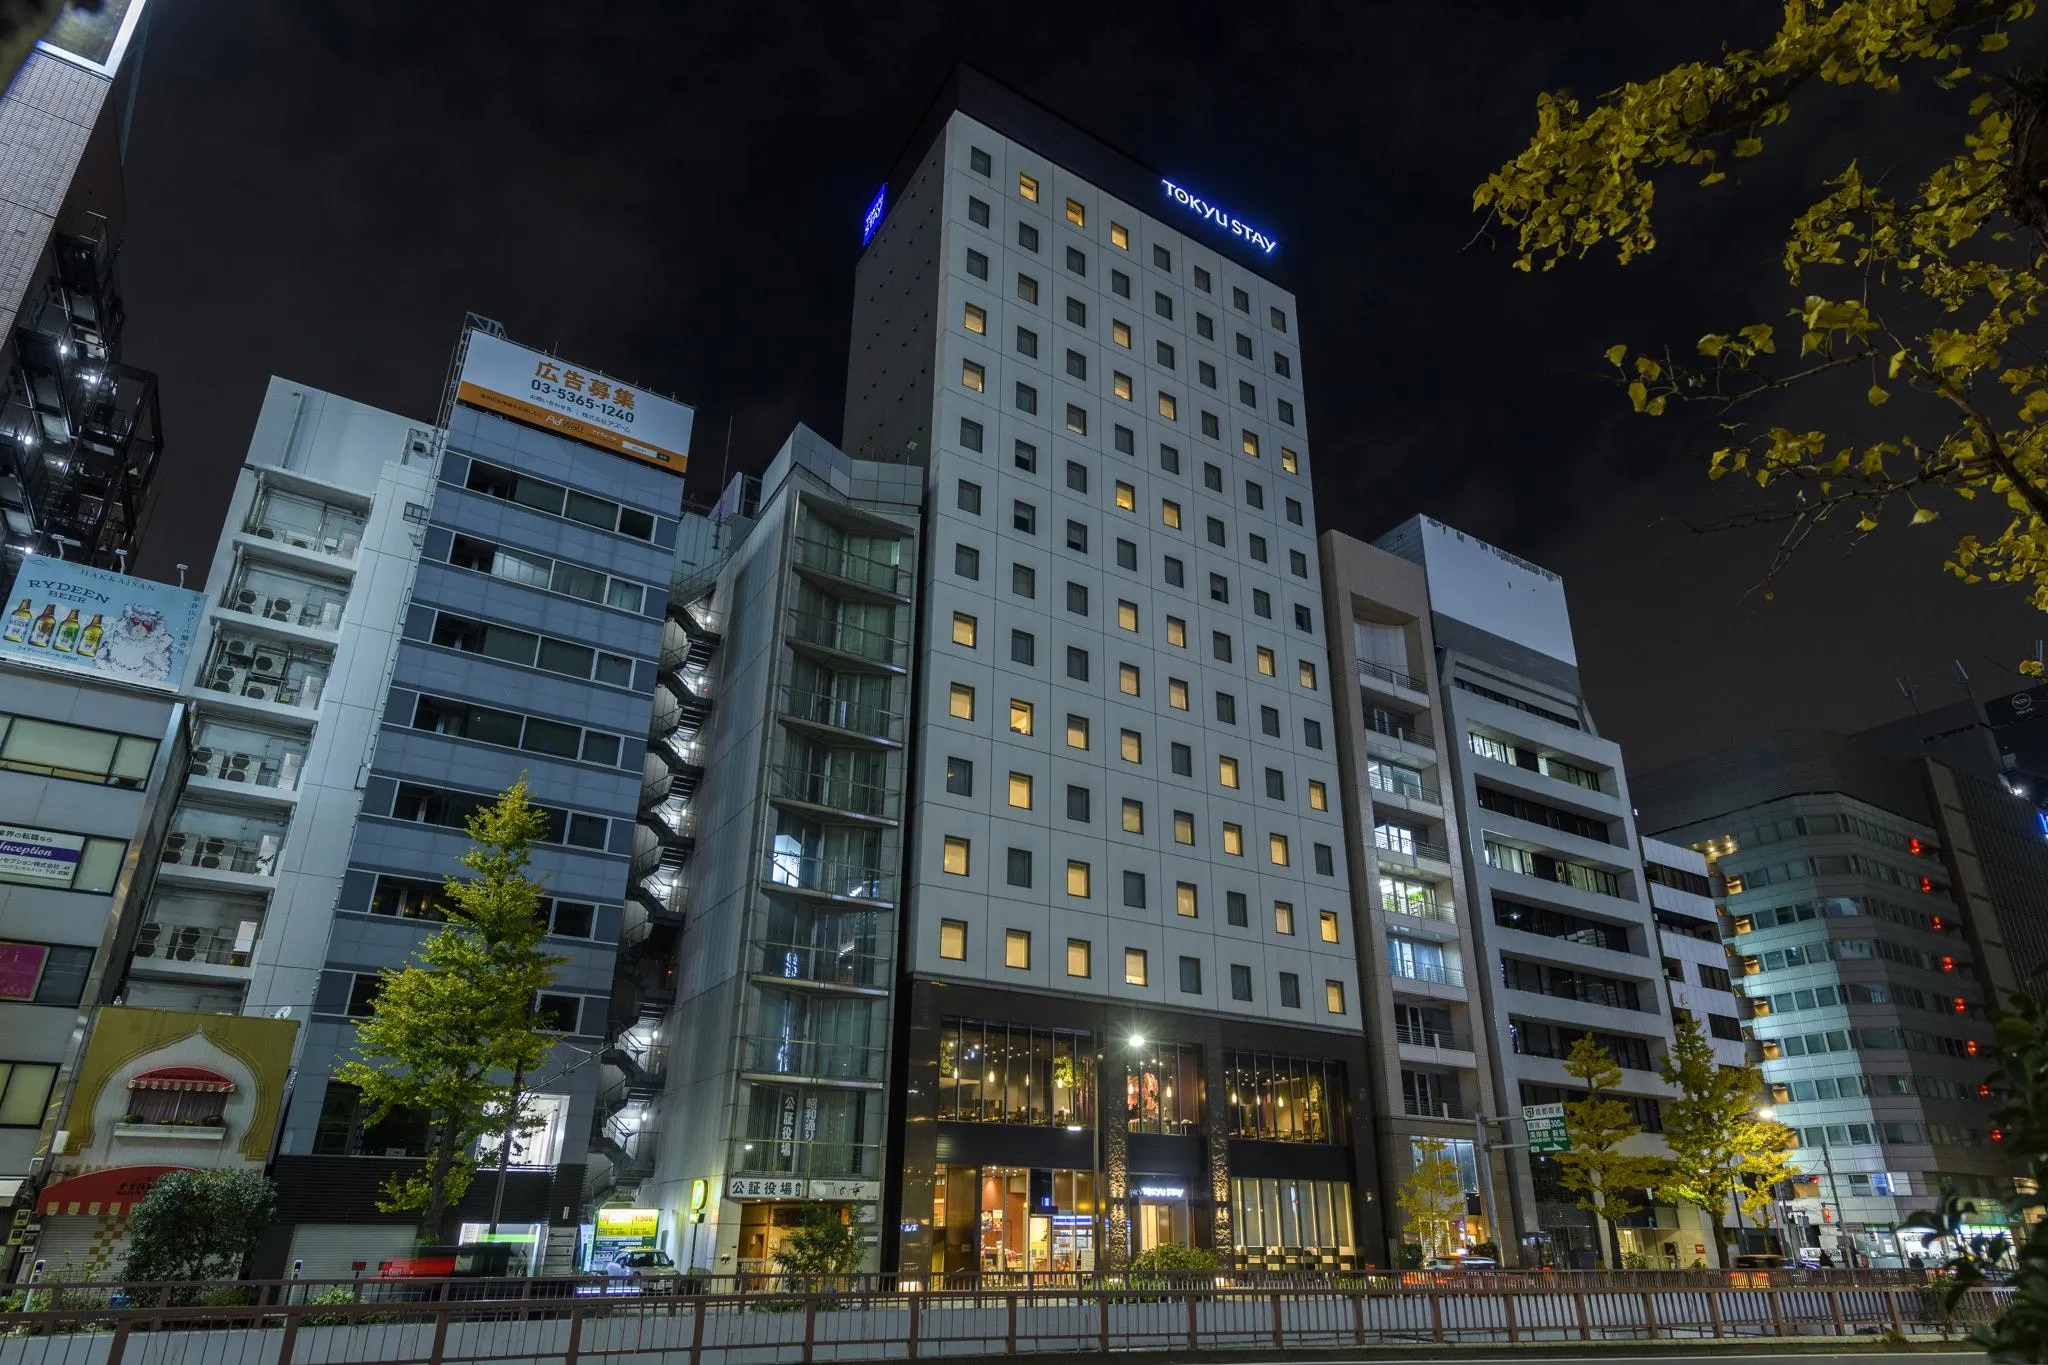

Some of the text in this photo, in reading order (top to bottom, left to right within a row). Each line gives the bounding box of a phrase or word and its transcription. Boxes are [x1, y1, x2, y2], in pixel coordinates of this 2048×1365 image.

[1161, 178, 1277, 254] TOKYU STAY
[531, 379, 635, 424] 03-5365-1240
[535, 360, 635, 410] 広告募集
[28, 578, 111, 604] RYDEEN
[48, 590, 87, 604] BEER
[80, 568, 156, 593] HAKKAISAN
[0, 840, 53, 857] Inception
[780, 1096, 795, 1157] 公証役場
[804, 1097, 818, 1141] 昭和通り
[732, 1180, 793, 1195] 公証役場
